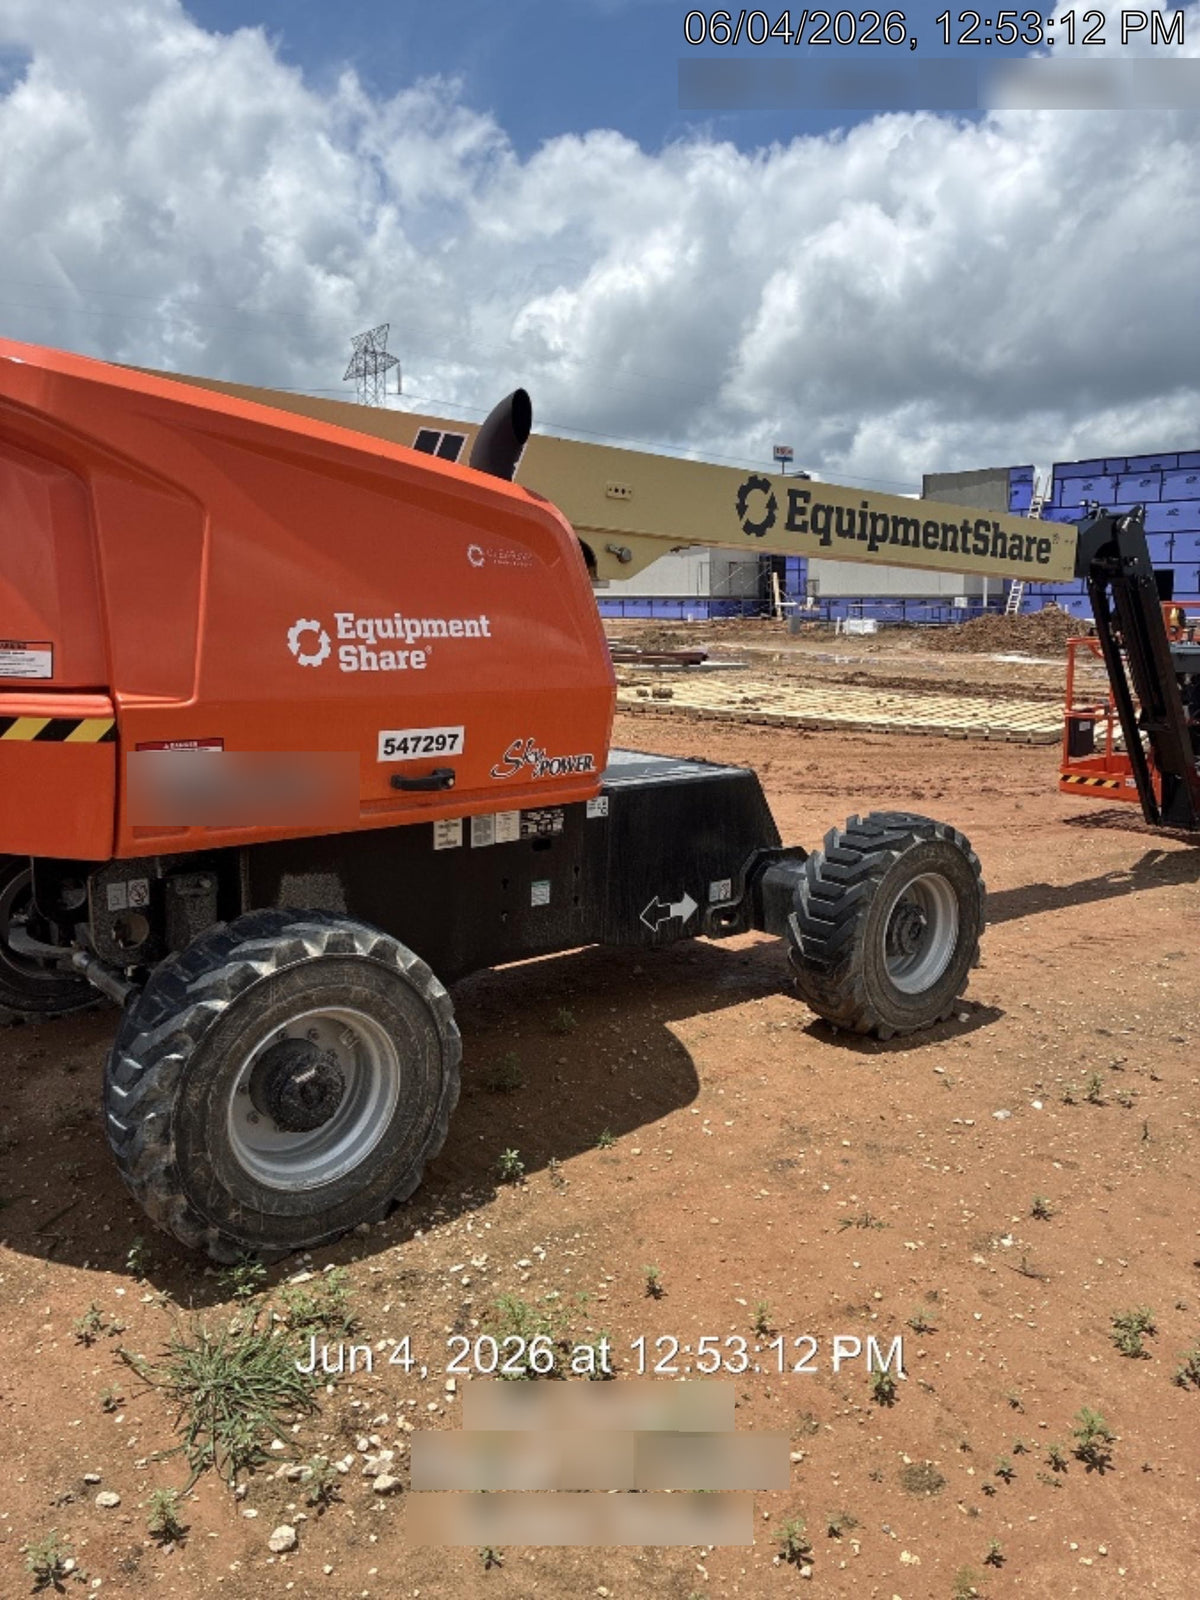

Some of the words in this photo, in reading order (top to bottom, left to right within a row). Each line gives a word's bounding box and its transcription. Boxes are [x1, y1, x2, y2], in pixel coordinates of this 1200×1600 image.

[784, 488, 1052, 564] EquipmentShare
[334, 613, 491, 644] Equipment
[383, 734, 460, 755] 547297
[490, 738, 547, 779] Sky
[540, 753, 597, 777] POWER
